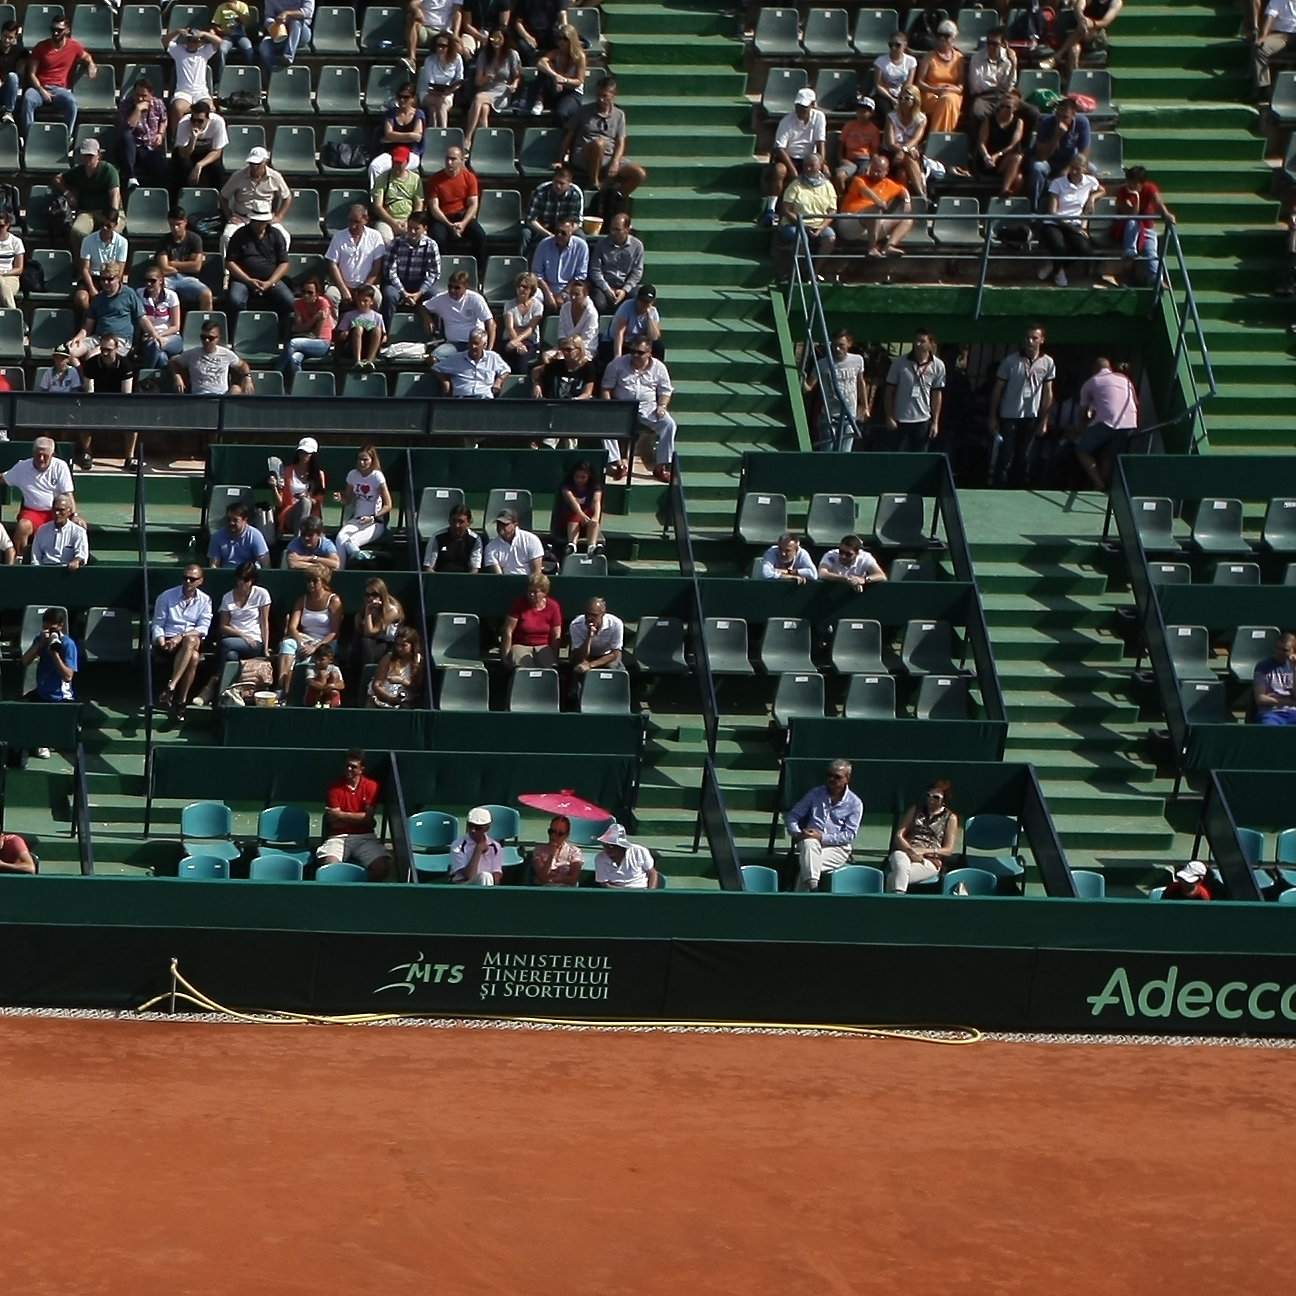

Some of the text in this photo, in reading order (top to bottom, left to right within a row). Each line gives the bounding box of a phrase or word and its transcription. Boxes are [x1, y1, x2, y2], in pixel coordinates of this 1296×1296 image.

[482, 952, 612, 969] MINISTERUL
[405, 963, 465, 984] MTS
[481, 967, 610, 985] TINERETULUI
[503, 981, 609, 1000] SPORTULUI
